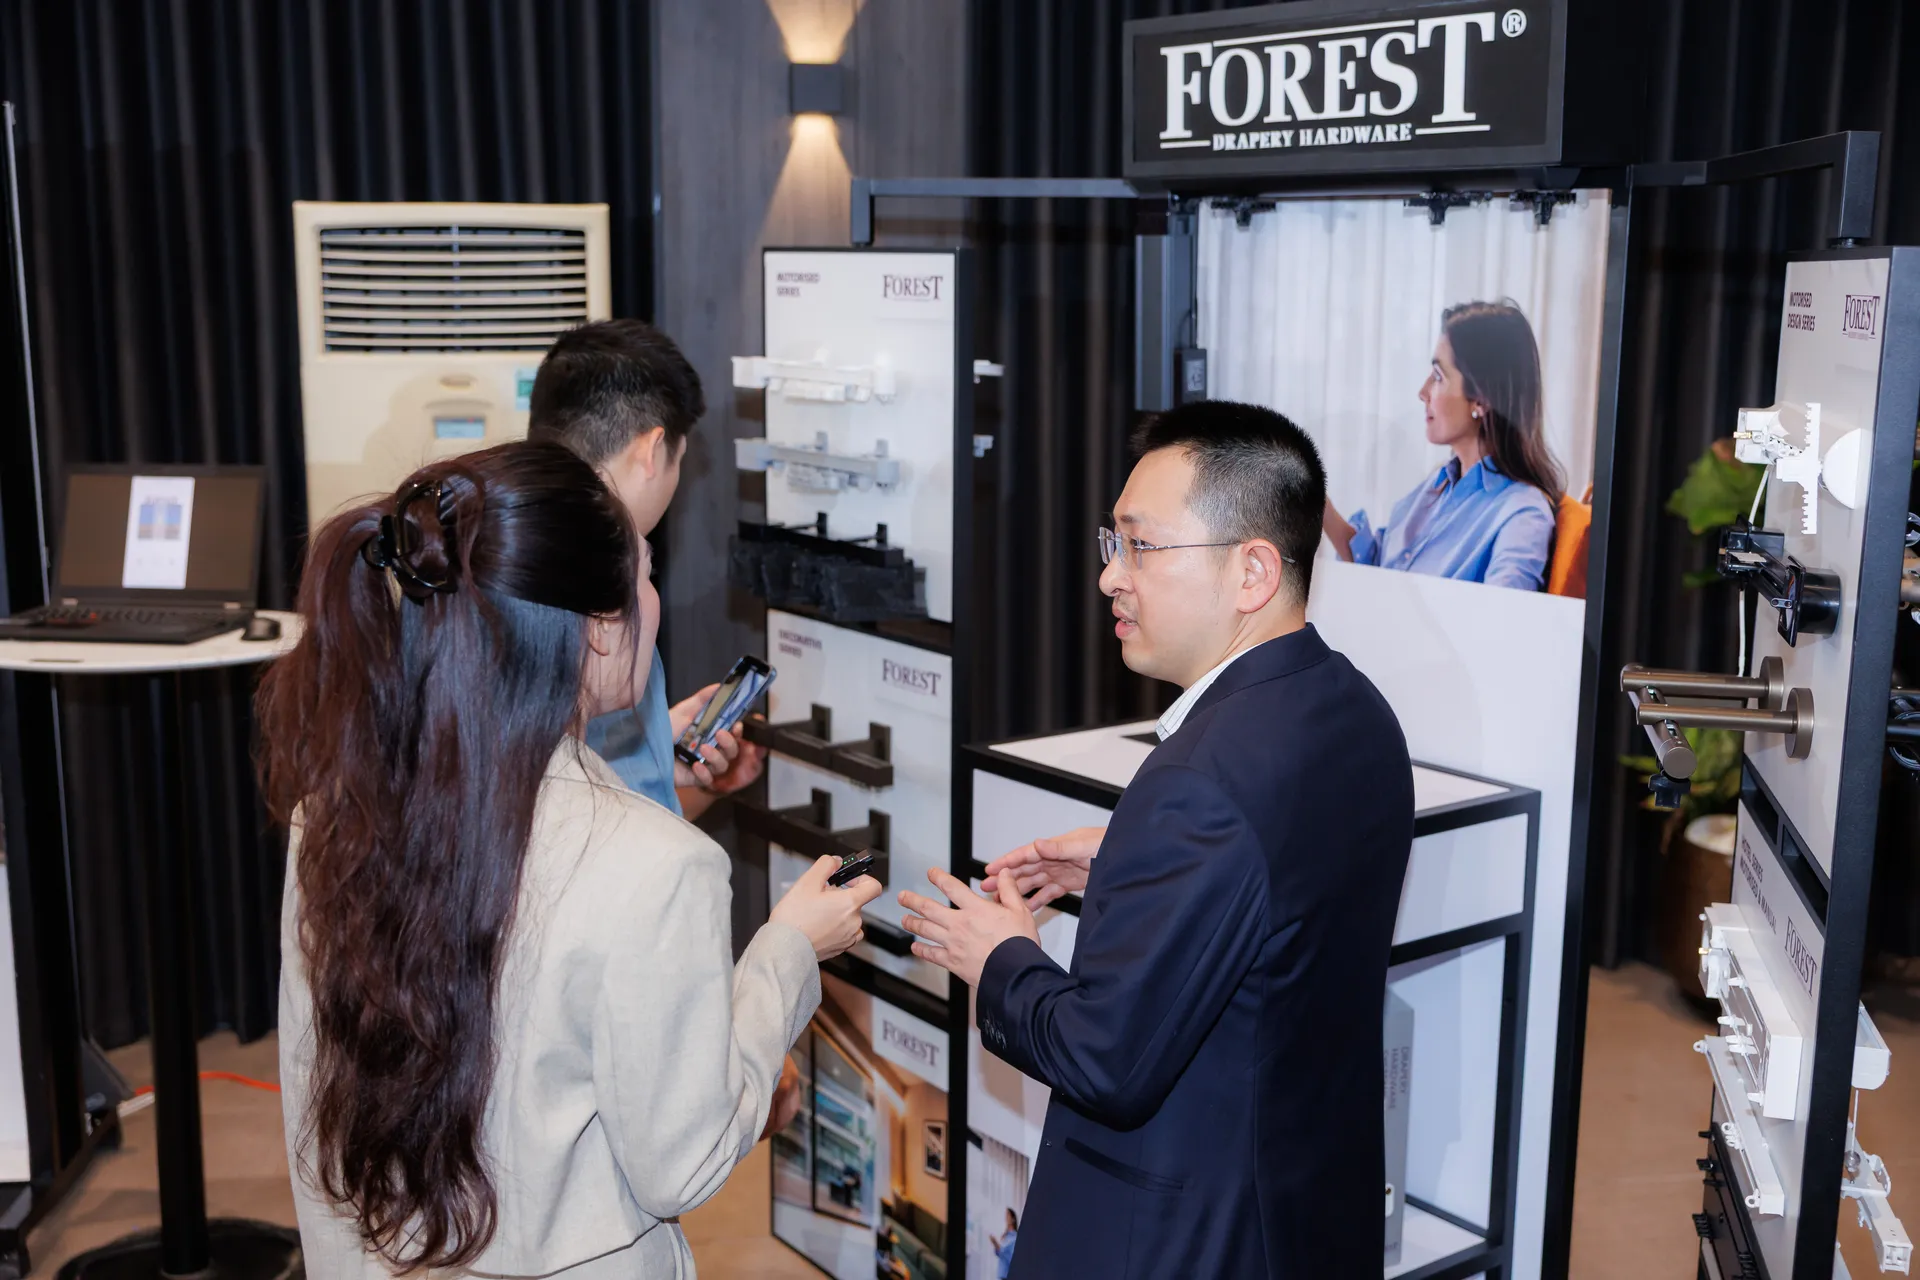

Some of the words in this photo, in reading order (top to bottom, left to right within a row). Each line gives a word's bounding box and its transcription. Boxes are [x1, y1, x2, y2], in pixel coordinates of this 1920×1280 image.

[1212, 129, 1295, 151] DRAPERY
[1299, 122, 1413, 147] HARDWARE
[883, 274, 943, 300] FOREST
[1789, 291, 1812, 308] MOTORISED
[1787, 313, 1801, 329] DESIGN
[1801, 315, 1816, 331] SERIES
[1842, 294, 1880, 335] FOREST
[882, 658, 942, 696] FOREST
[1752, 852, 1764, 883] SERIES
[1740, 855, 1759, 898] MOTORISED
[1761, 895, 1777, 935] MANUAL
[1784, 915, 1818, 998] FOREST
[882, 1019, 940, 1067] FOREST
